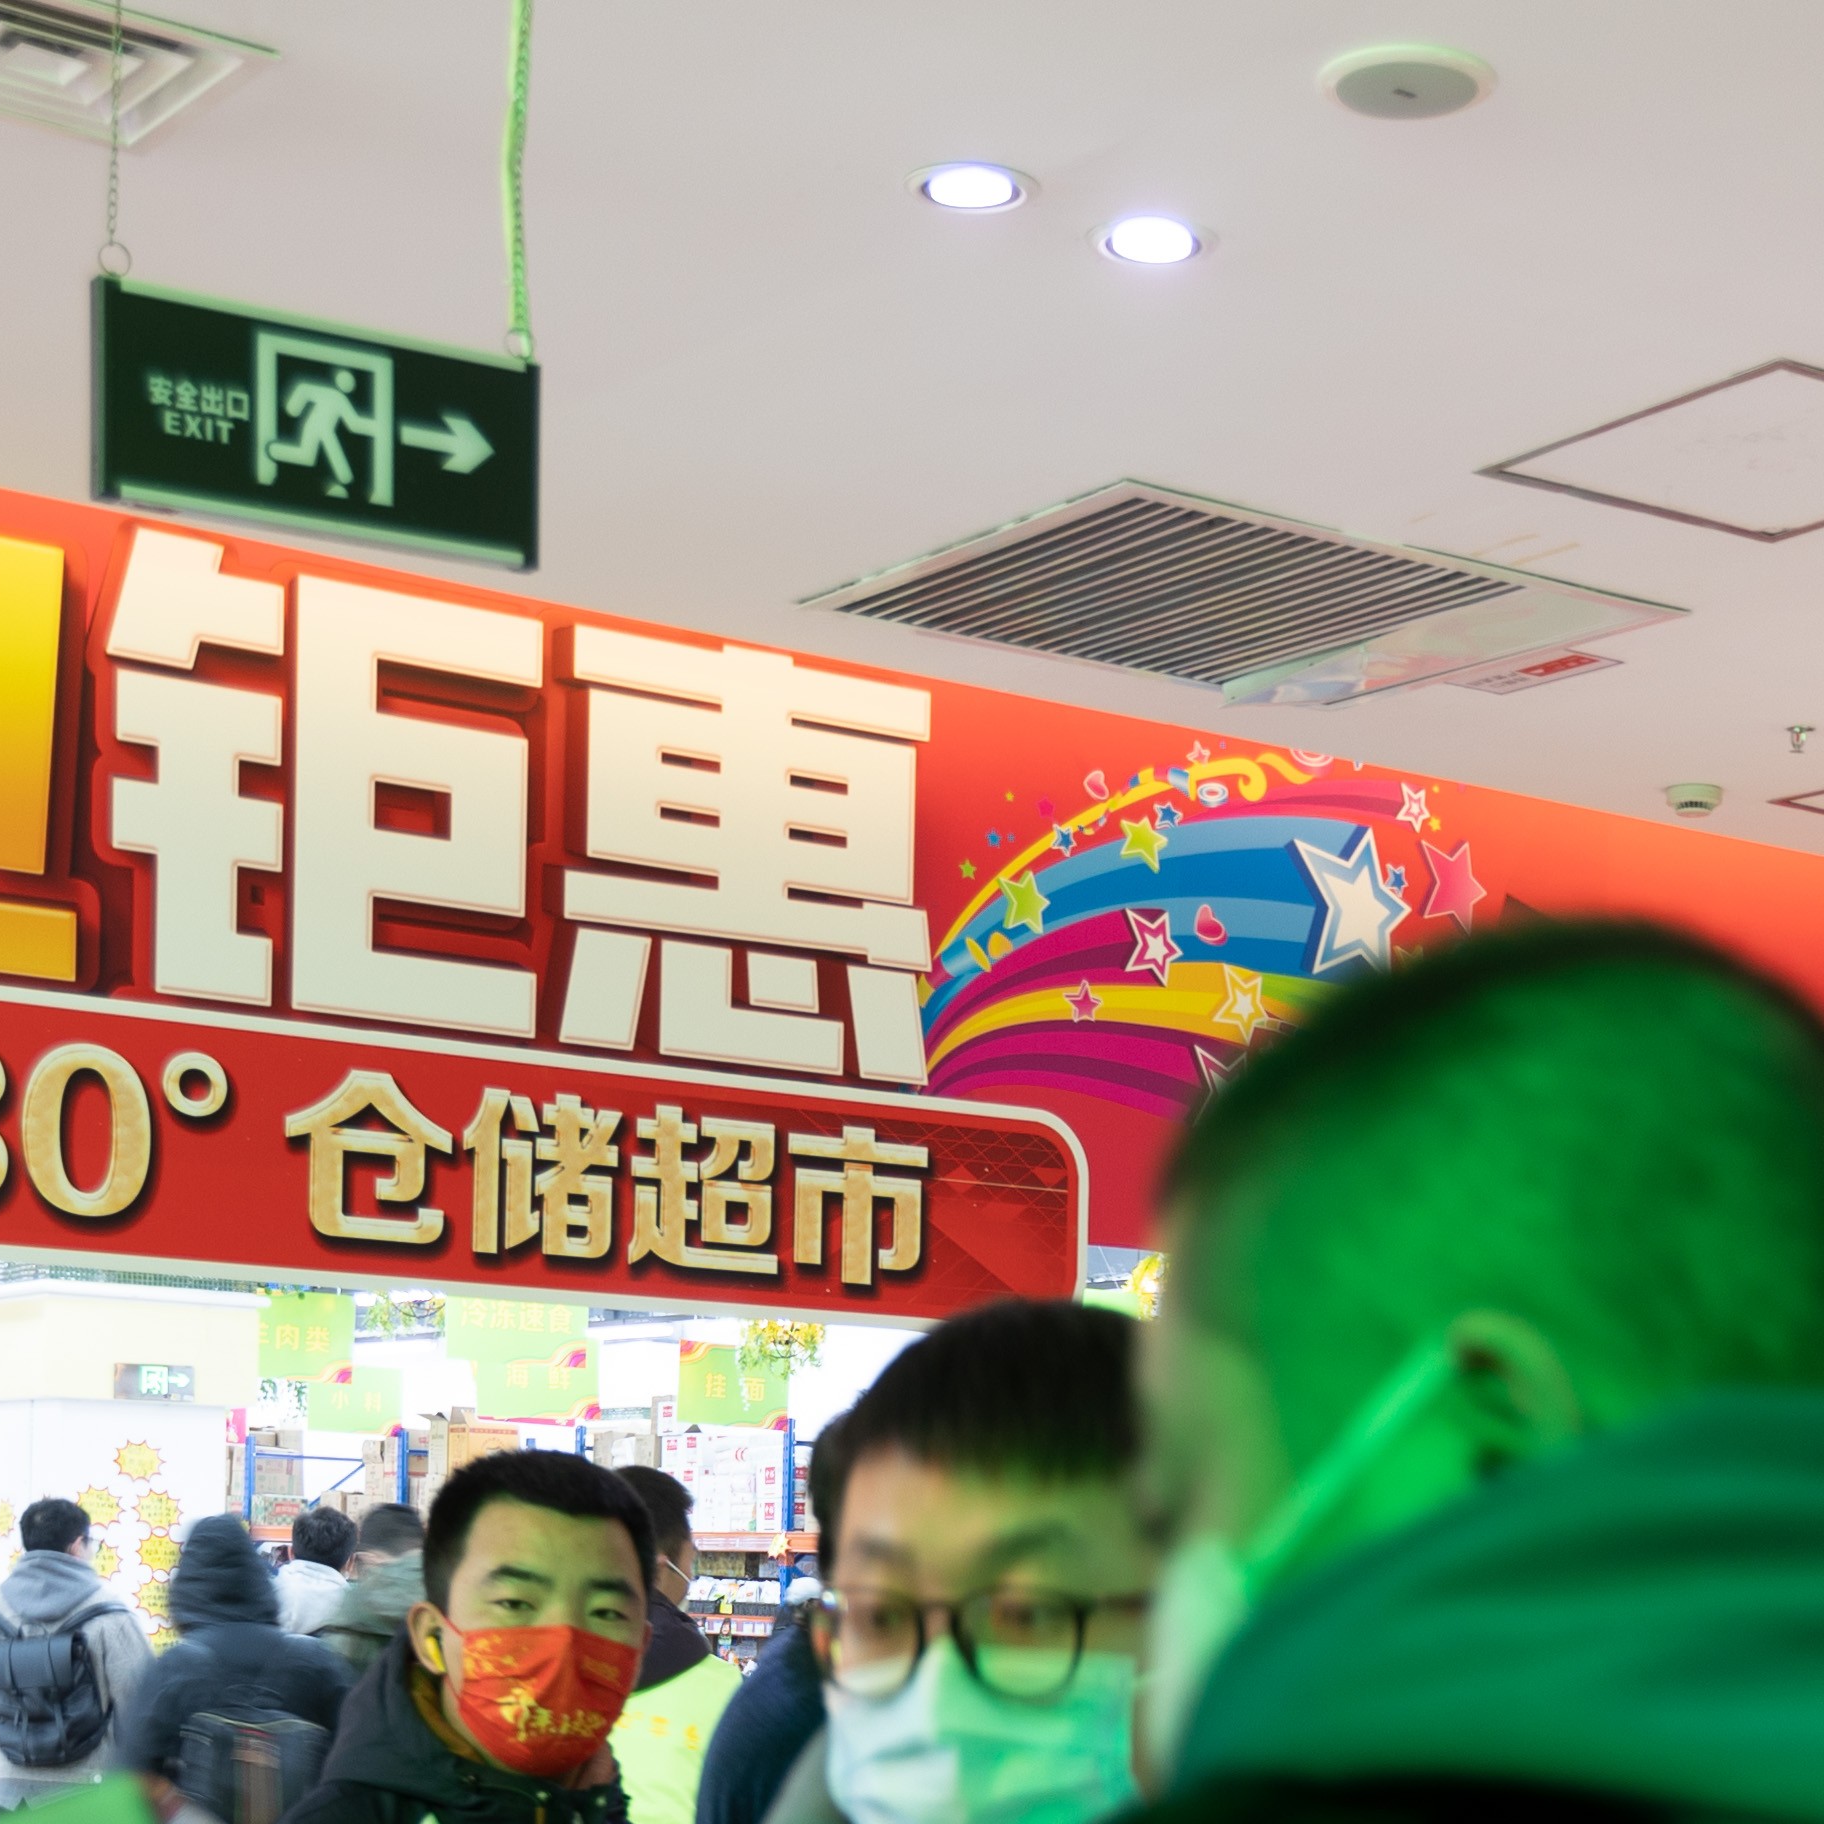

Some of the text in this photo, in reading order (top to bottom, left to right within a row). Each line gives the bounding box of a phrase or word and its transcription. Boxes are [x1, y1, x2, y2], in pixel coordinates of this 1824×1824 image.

[148, 374, 250, 423] 安全出口
[163, 411, 235, 445] EXIT
[284, 1068, 933, 1289] 仓储超市
[460, 1298, 574, 1336] 冷冻速食
[506, 1363, 572, 1391] 海鲜
[703, 1372, 765, 1402] 挂面
